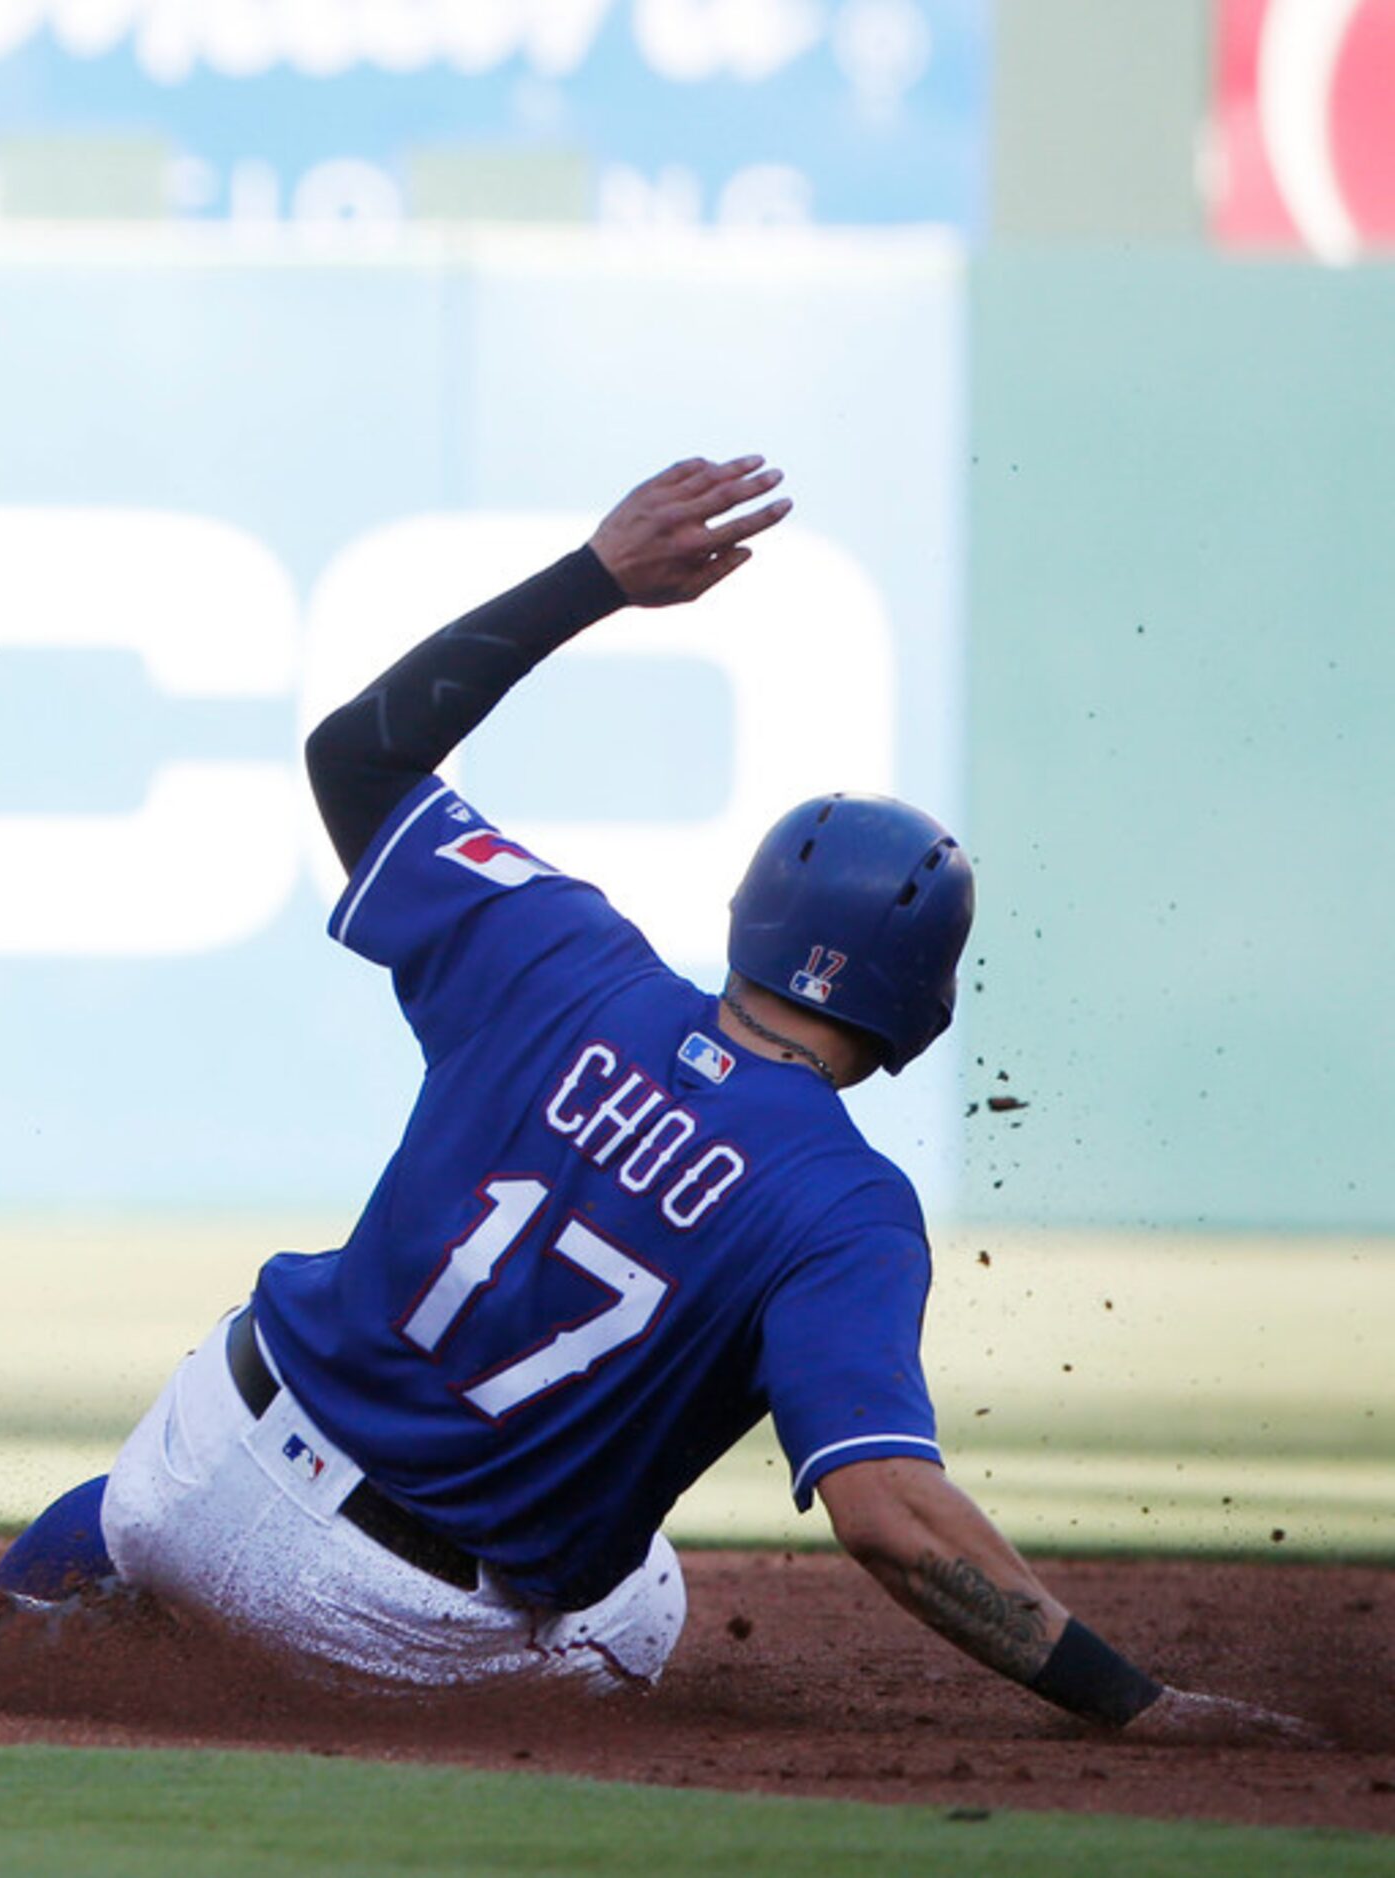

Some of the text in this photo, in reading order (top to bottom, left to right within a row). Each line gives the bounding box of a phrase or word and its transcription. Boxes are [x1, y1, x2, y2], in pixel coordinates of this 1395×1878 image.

[806, 945, 848, 981] 17
[545, 1039, 748, 1230] CHOO
[393, 1172, 678, 1427] 17
